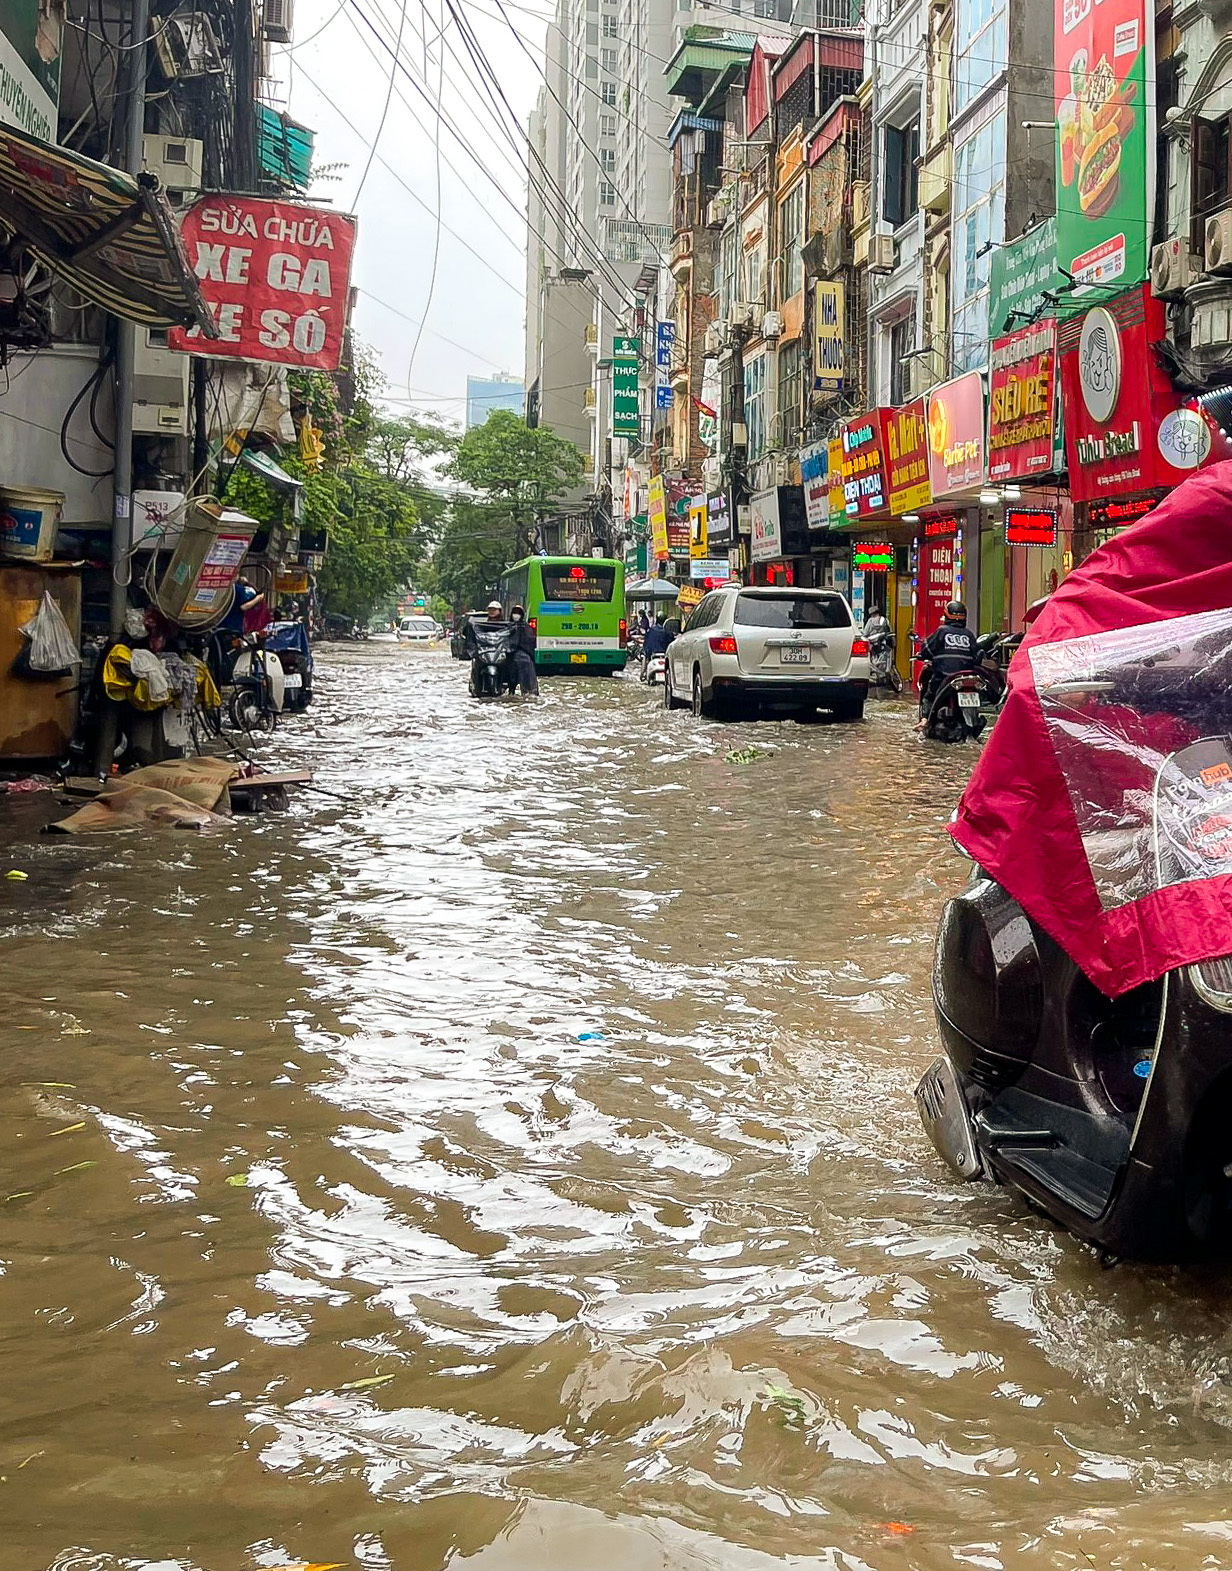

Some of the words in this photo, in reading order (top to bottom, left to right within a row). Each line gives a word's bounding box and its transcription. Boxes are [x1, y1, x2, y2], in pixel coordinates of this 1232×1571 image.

[201, 204, 258, 239] SỬA
[263, 216, 335, 250] CHỮA
[194, 241, 252, 285] XE
[267, 252, 333, 298] GA
[258, 306, 332, 355] SỐ
[614, 366, 638, 377] THỰC
[614, 385, 638, 398] PHẨM
[614, 411, 638, 422] SẠCH
